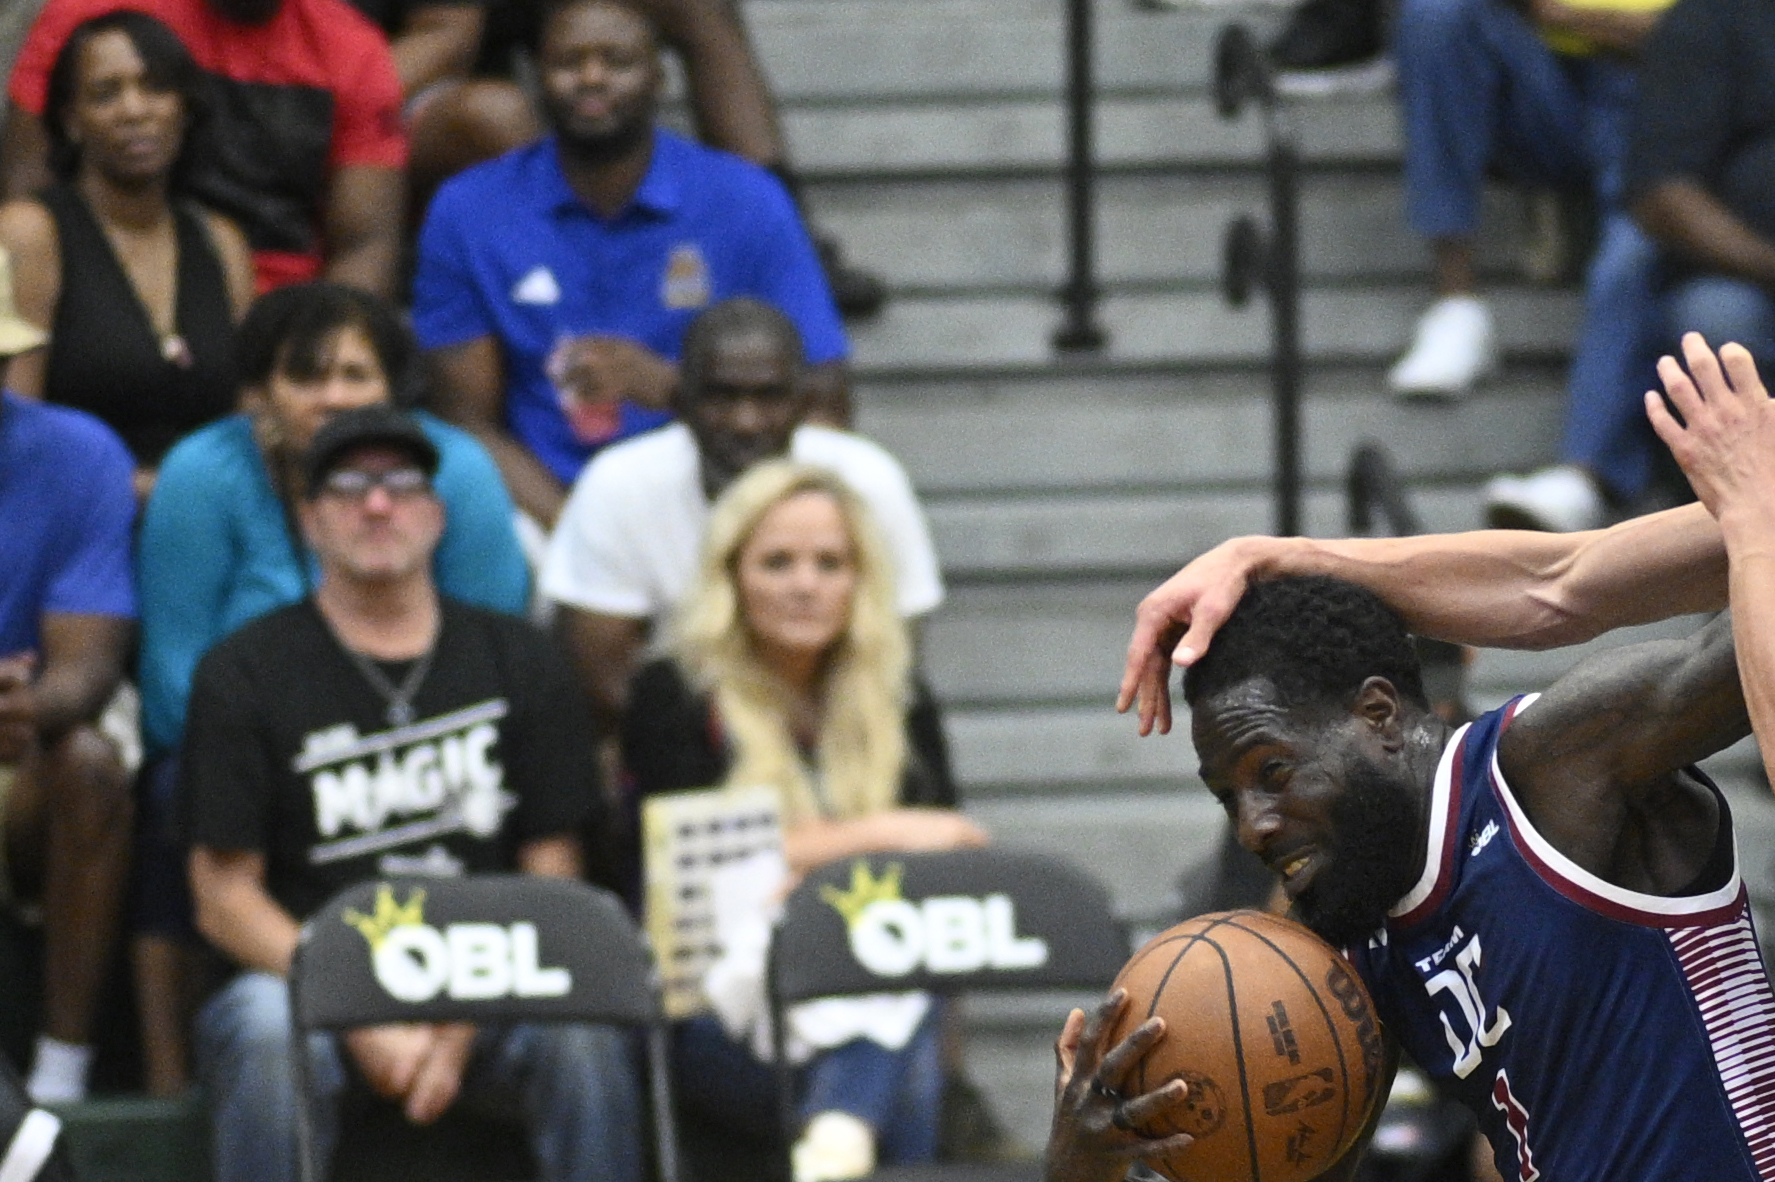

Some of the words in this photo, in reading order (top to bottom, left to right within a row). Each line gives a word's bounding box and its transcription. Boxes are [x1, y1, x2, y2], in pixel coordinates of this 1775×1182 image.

[311, 723, 504, 836] MAGIC
[373, 921, 574, 1003] OBL
[850, 892, 1048, 977] OBL
[1425, 933, 1512, 1080] DC
